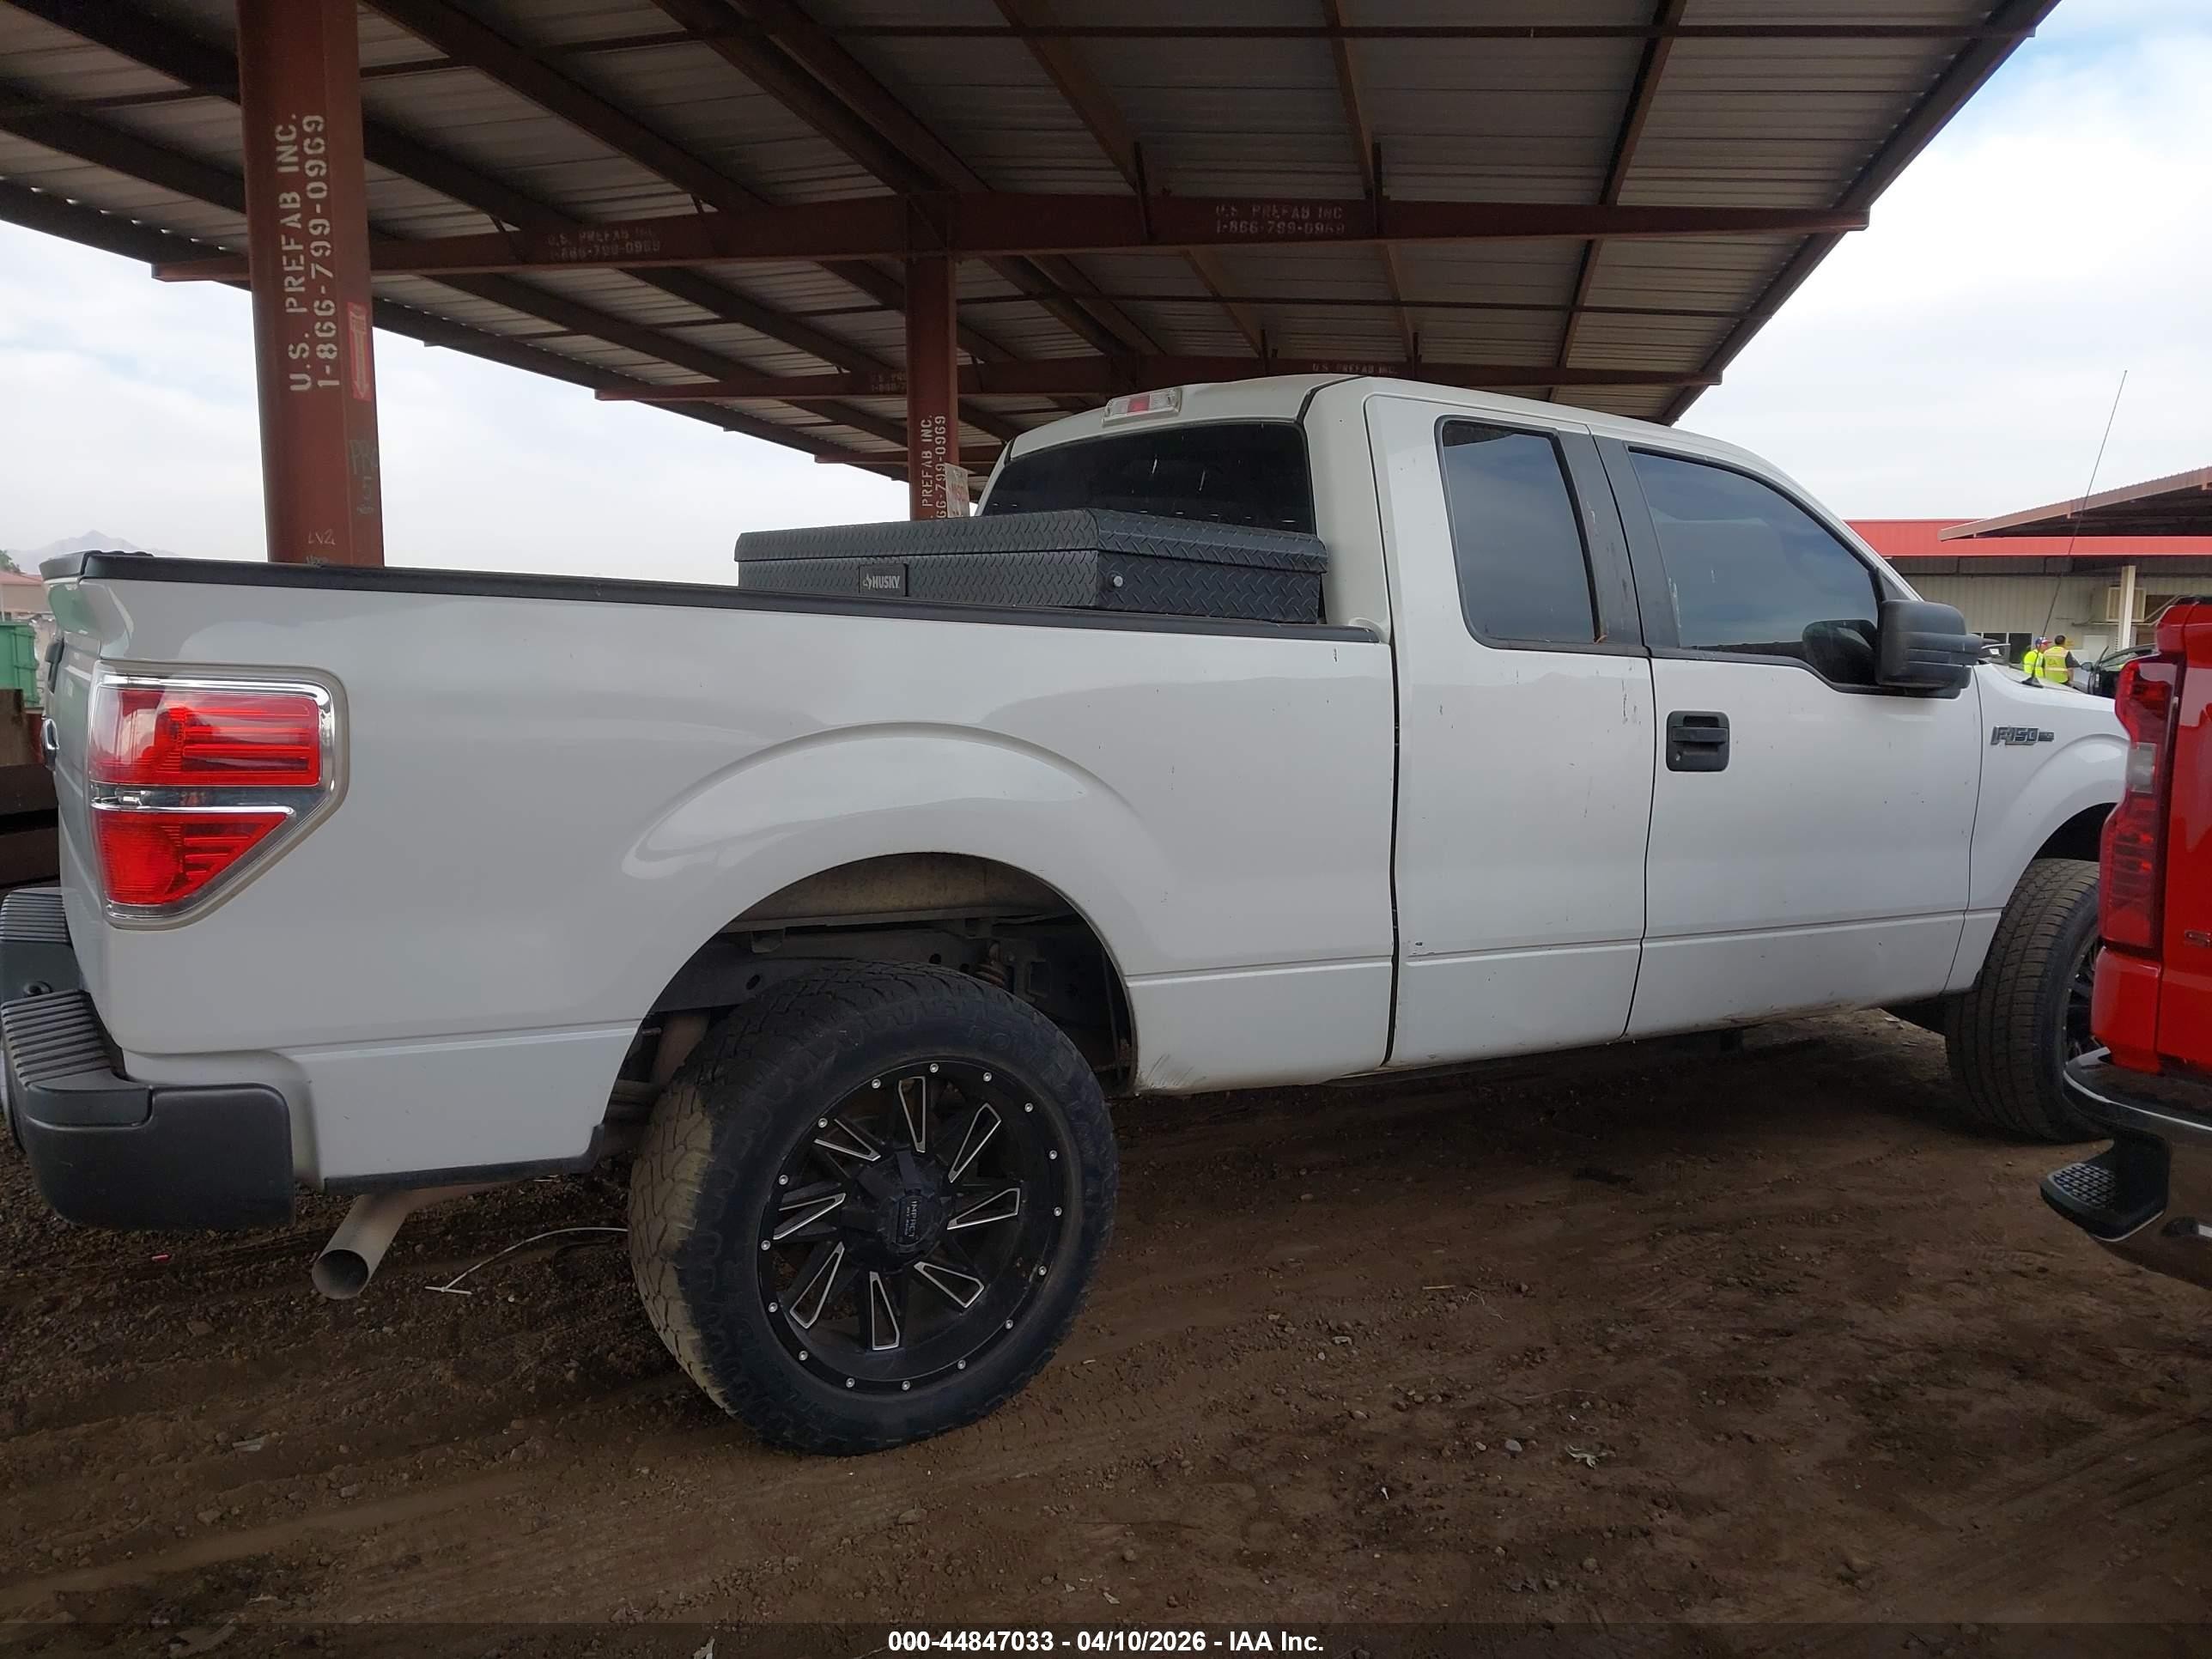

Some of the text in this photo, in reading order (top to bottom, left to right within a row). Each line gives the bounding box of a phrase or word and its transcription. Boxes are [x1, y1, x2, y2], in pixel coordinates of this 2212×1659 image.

[275, 112, 312, 392] U.S. PREFAB INC.
[301, 114, 340, 387] 1-866-799-0969
[920, 415, 933, 507] PREFAB INC.
[872, 574, 901, 590] HUSKY
